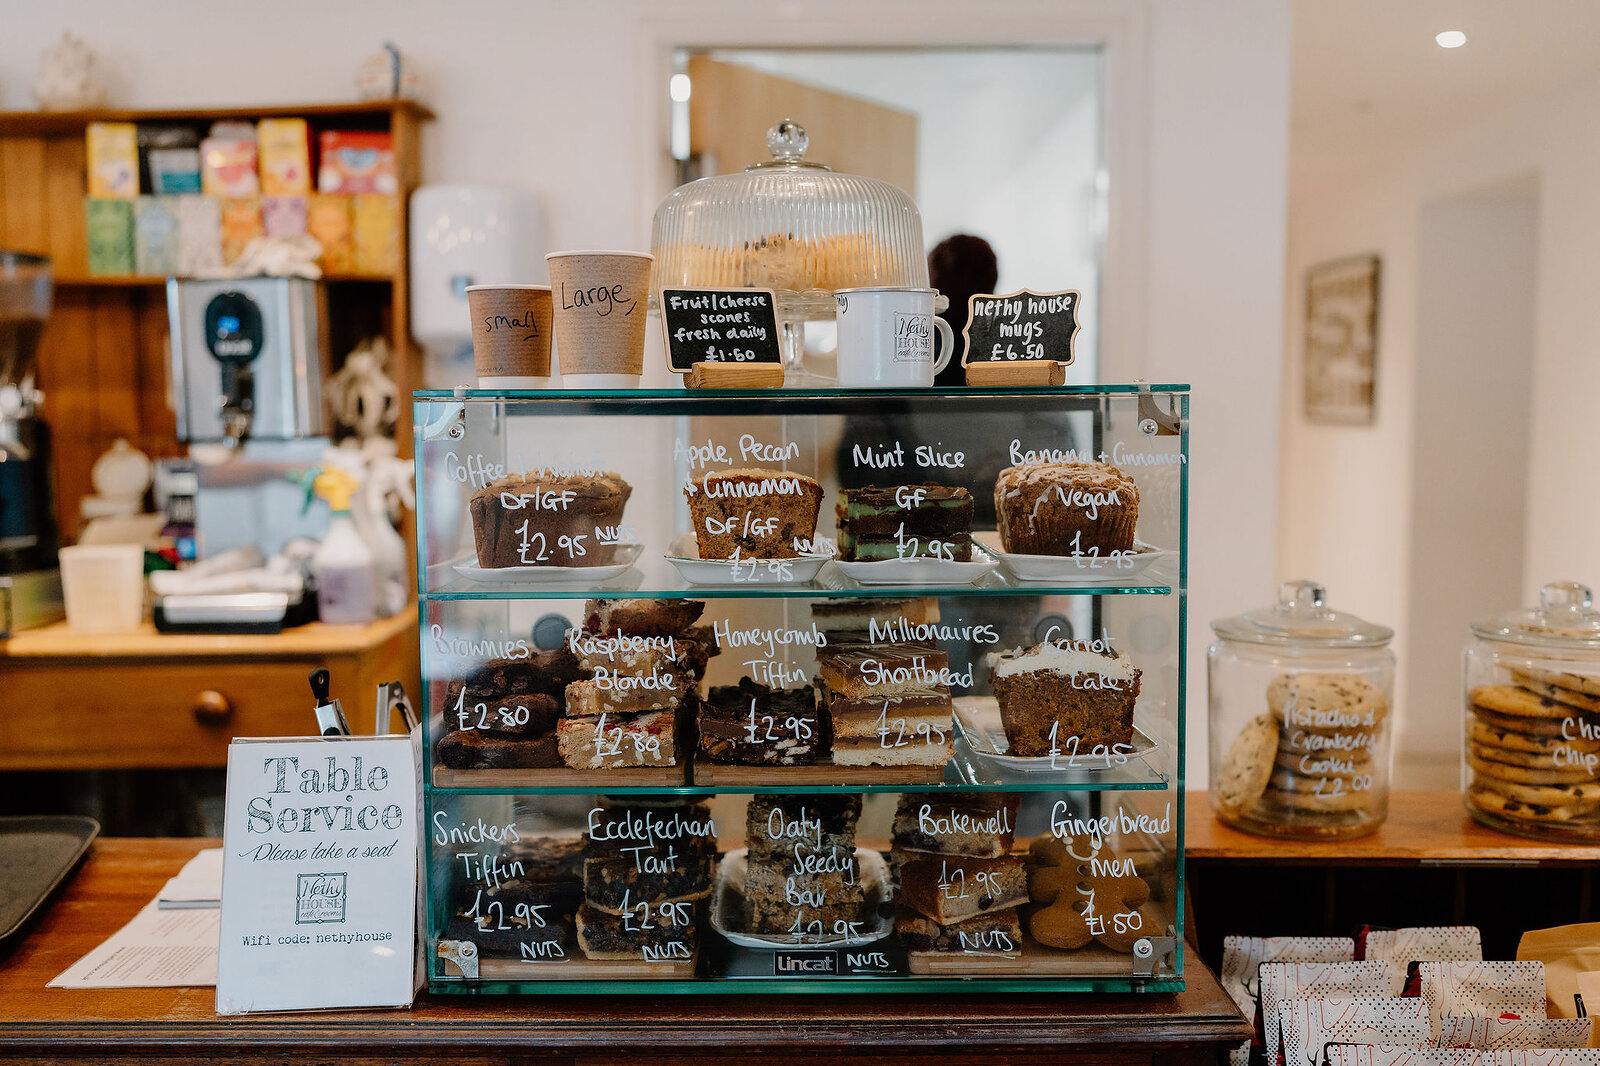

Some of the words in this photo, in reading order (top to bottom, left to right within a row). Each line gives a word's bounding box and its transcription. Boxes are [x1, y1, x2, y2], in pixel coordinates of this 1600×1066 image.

[562, 281, 632, 317] Large
[974, 299, 1023, 325] nethy
[1028, 296, 1072, 314] house
[484, 310, 538, 333] small
[674, 327, 721, 343] fresh
[726, 325, 767, 341] daily
[700, 311, 751, 325] scones
[999, 321, 1044, 346] mugs
[704, 345, 756, 363] £1.60
[897, 338, 930, 349] HOUSE
[990, 343, 1045, 362] £6.50
[673, 437, 733, 469] Apple,
[738, 434, 800, 462] Pecan
[852, 441, 905, 469] Mint
[914, 442, 965, 469] Slice
[1009, 438, 1094, 467] Banana
[1098, 450, 1109, 465] +
[1112, 440, 1187, 467] Cinnamon
[444, 451, 507, 489] Coffee
[703, 470, 804, 499] Cinnamon
[895, 485, 928, 511] GF
[1056, 486, 1122, 521] Vegan
[594, 524, 640, 544] NUTS
[705, 510, 780, 539] DF/GF
[514, 518, 588, 564] £2.95
[793, 536, 838, 557] NUTS
[893, 521, 956, 564] £2.95
[1069, 530, 1138, 569] £2.95
[728, 545, 794, 582] £2.95
[431, 623, 530, 660] Brownies
[569, 626, 677, 662] Raspberry
[713, 618, 828, 658] Honeycomb
[868, 616, 1000, 645] Millionaires
[1043, 625, 1116, 655] Carrot
[742, 660, 808, 690] Tiffin
[860, 656, 975, 689] Shortbread
[1071, 664, 1124, 692] Cake
[453, 686, 530, 731] £2.80
[743, 698, 815, 744] £2.95
[875, 700, 947, 749] £2.95
[1048, 720, 1133, 771] £2.95
[1552, 744, 1599, 776] Chip
[264, 756, 389, 794] Table
[247, 795, 403, 834] Service
[433, 810, 521, 847] Snickers
[587, 807, 718, 848] Ecclefechan
[767, 806, 821, 851] Oaty
[918, 804, 1012, 836] Bakewell
[1050, 800, 1171, 850] Gingerbread
[239, 842, 307, 863] Please
[310, 841, 344, 860] take
[346, 846, 358, 859] a
[362, 839, 399, 858] seat
[620, 845, 679, 875] Tart
[793, 843, 854, 886] Seedy
[455, 852, 526, 890] Tiffin
[937, 860, 1003, 899] £2.95
[300, 898, 343, 910] HOUSE
[301, 877, 343, 900] Nethy
[785, 876, 828, 908] Bar
[464, 889, 552, 933] £2.95
[618, 889, 692, 932] £2.95
[1080, 891, 1142, 936] £1.50
[242, 934, 272, 946] Wifi
[278, 933, 311, 945] code:
[316, 931, 393, 945] nethyhouse
[787, 910, 865, 948] £2.95
[959, 930, 1014, 952] NUTS
[520, 939, 566, 960] NUTS
[641, 941, 692, 960] NUTS
[846, 952, 891, 968] NUTS
